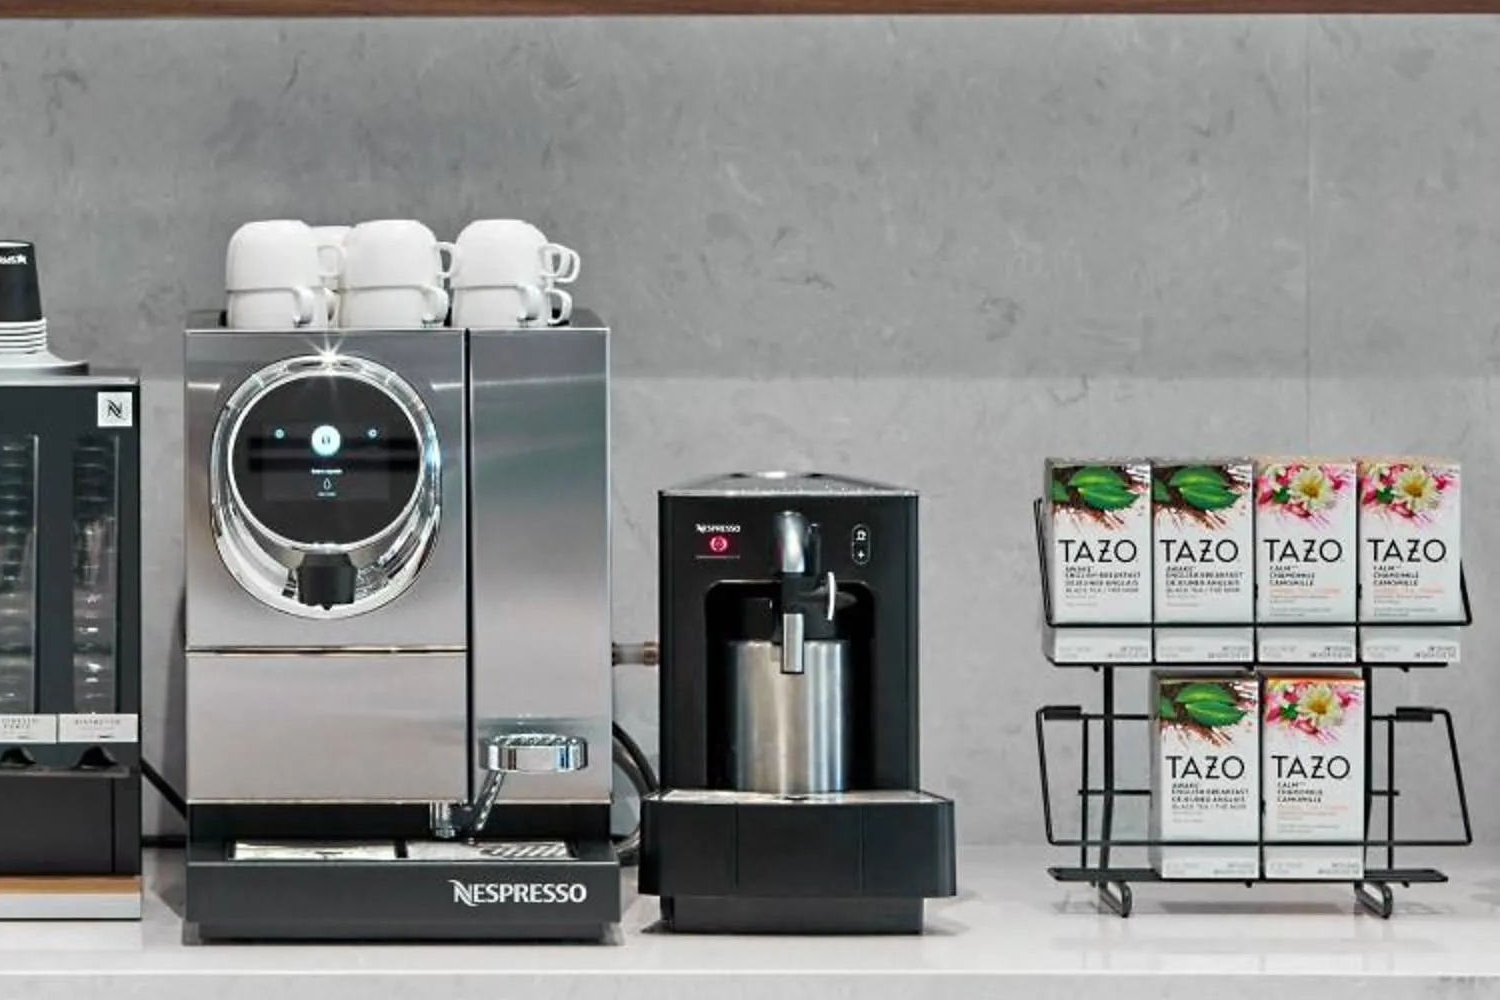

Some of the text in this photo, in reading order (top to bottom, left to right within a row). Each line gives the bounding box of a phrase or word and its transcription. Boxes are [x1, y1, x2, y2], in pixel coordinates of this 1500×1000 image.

[1058, 539, 1138, 563] TAZO
[1159, 539, 1239, 563] TAZO
[1263, 539, 1343, 563] TAZO
[1367, 539, 1447, 563] TAZO
[1165, 755, 1245, 779] TAZO
[1271, 755, 1351, 779] TAZO
[448, 879, 588, 907] NESPRESSO
